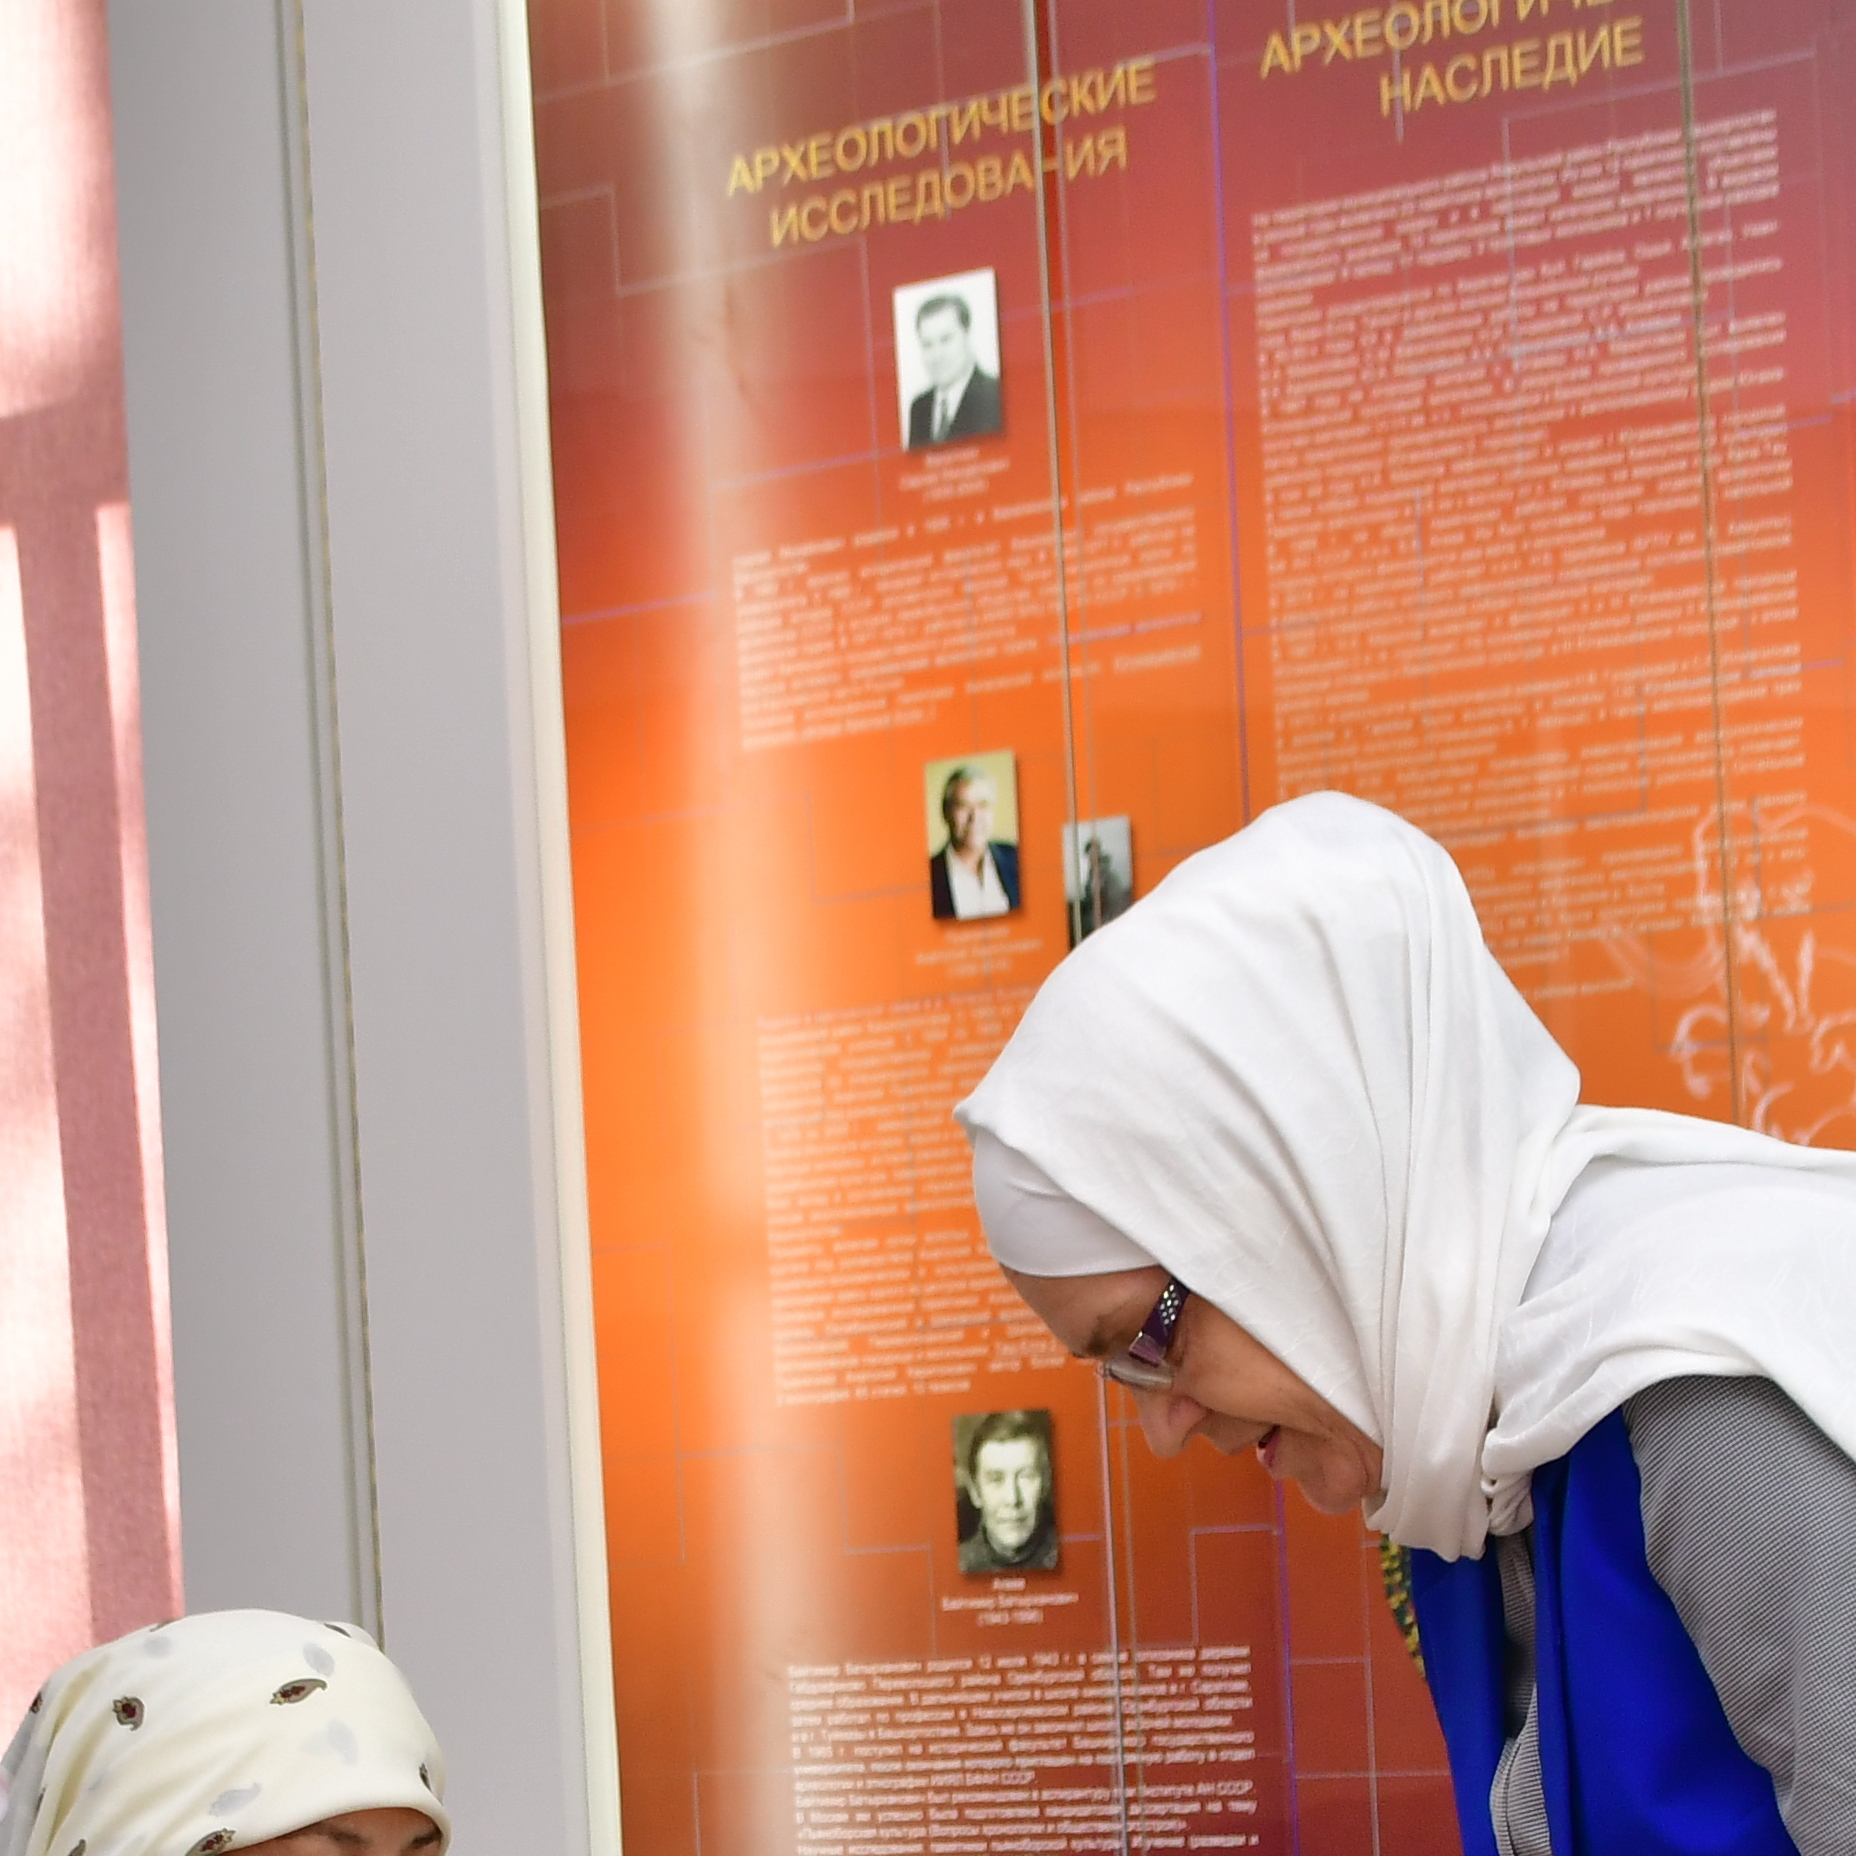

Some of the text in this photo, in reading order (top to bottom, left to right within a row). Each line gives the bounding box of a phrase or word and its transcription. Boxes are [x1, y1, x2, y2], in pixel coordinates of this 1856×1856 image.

[1259, 0, 1617, 80] АРХЕОЛОГ
[1379, 14, 1644, 118] НАСЛЕДИЕ
[728, 55, 1157, 196] АРХЕОЛОГИЧЕСКИЕ
[769, 125, 1128, 248] ИССЛЕДОВАИЯ
